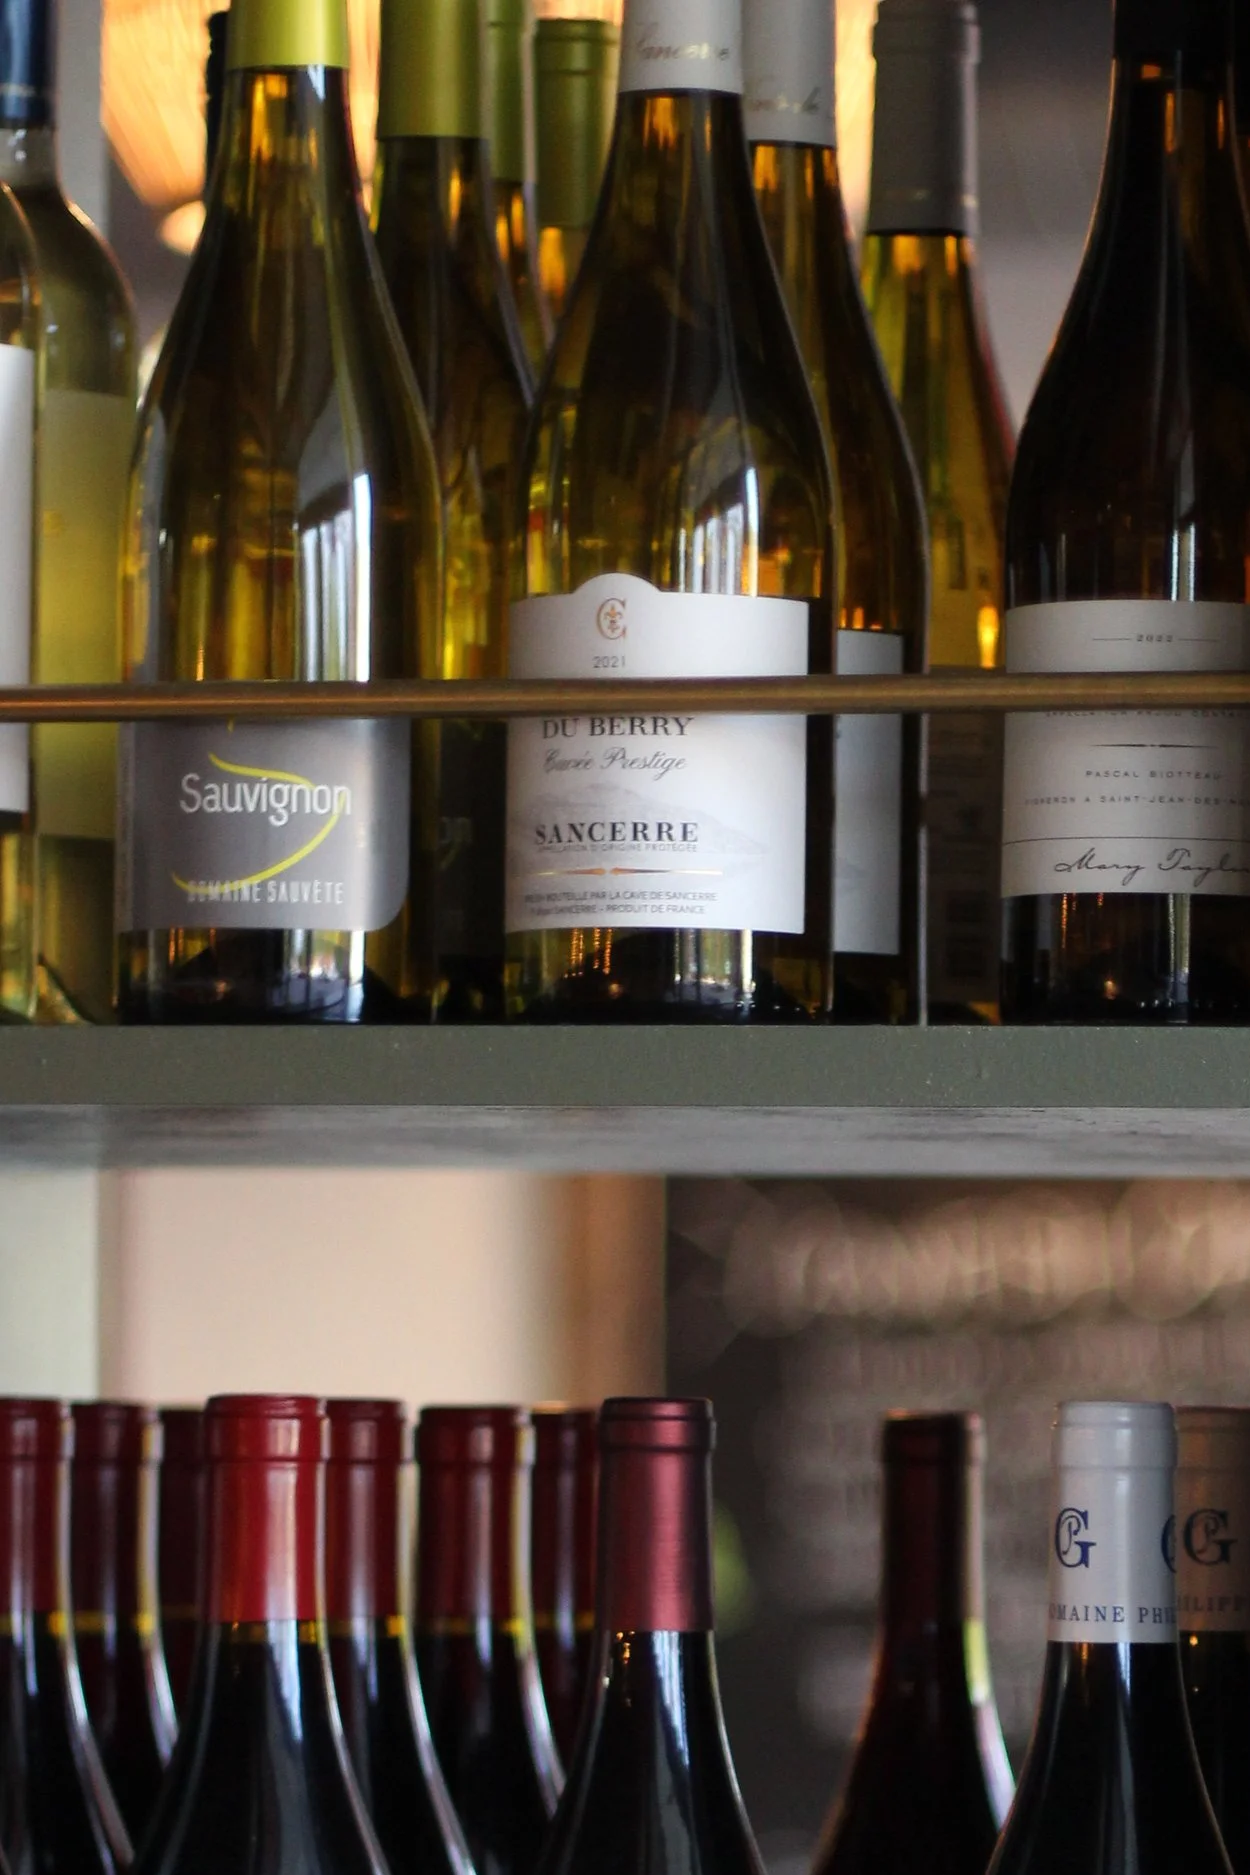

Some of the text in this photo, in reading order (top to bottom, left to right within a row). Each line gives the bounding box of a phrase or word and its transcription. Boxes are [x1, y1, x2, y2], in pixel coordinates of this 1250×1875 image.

[592, 655, 626, 669] 2021
[543, 715, 695, 740] DU BERRY
[600, 745, 688, 781] Prestige
[180, 773, 351, 826] Sauvignon
[534, 820, 699, 846] SANCERRE
[1054, 847, 1145, 886] Mary
